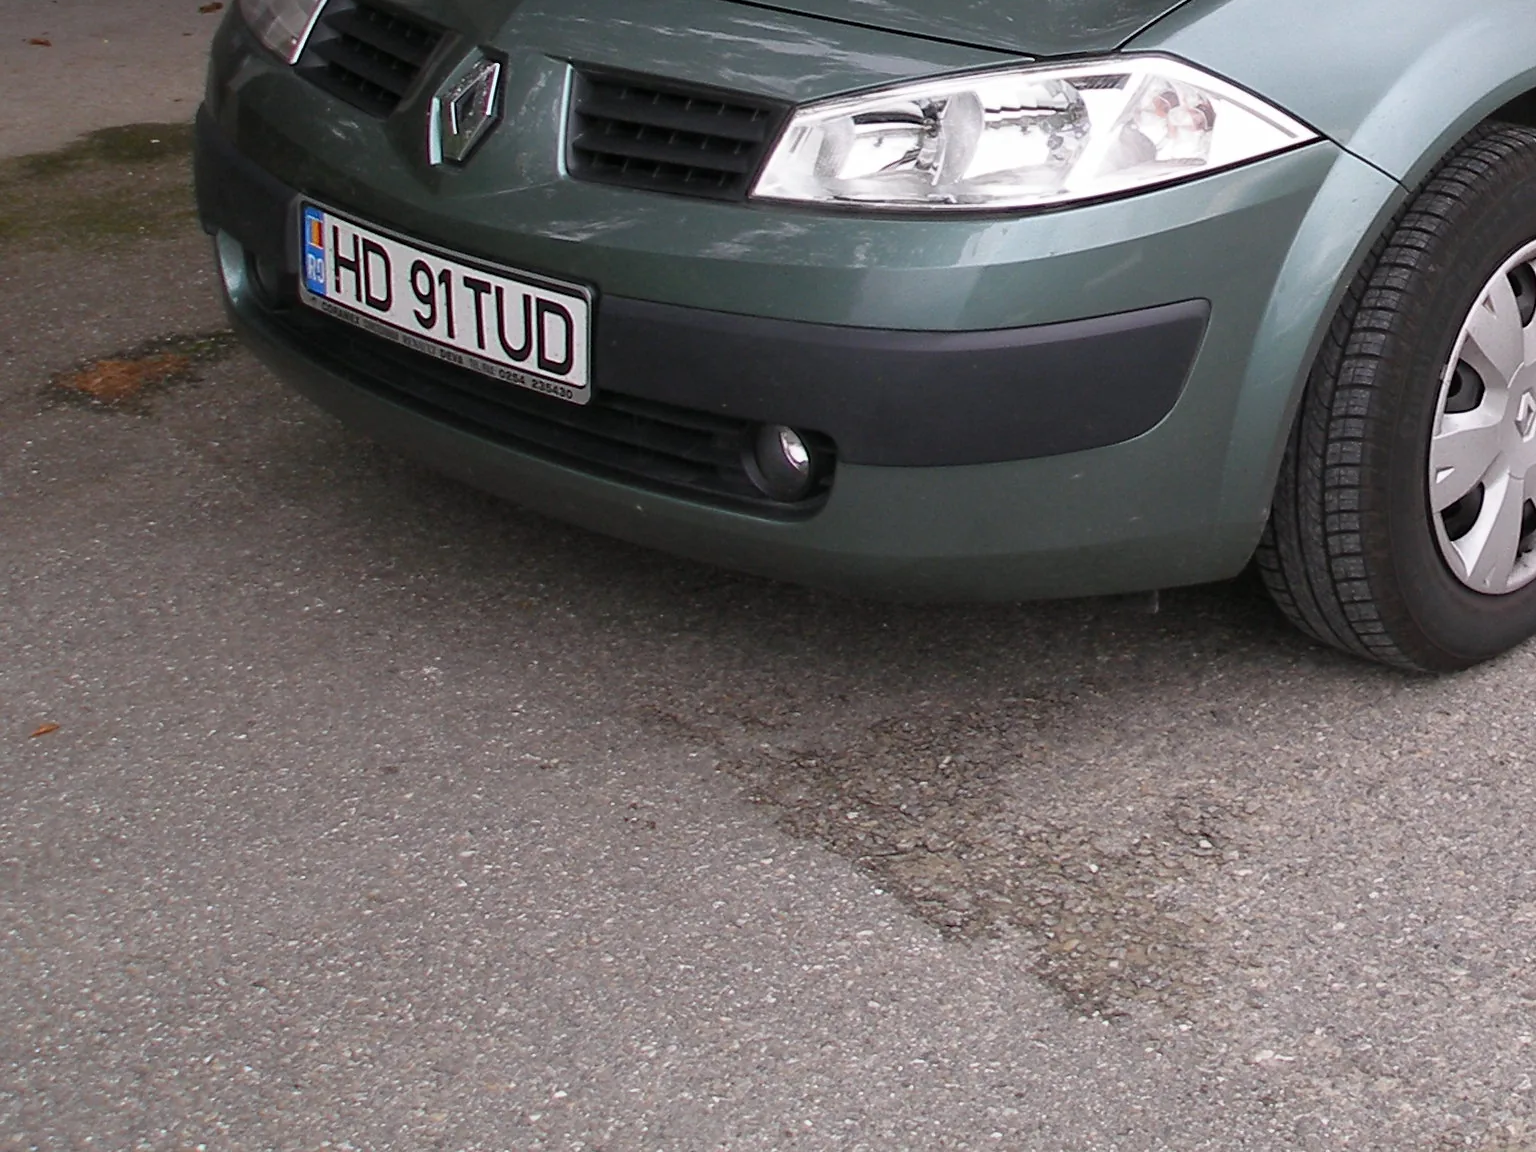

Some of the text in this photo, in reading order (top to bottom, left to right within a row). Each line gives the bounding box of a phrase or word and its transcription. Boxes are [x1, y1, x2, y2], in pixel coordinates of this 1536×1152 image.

[307, 253, 325, 283] RO
[332, 224, 393, 312] HD
[499, 368, 525, 385] 0254
